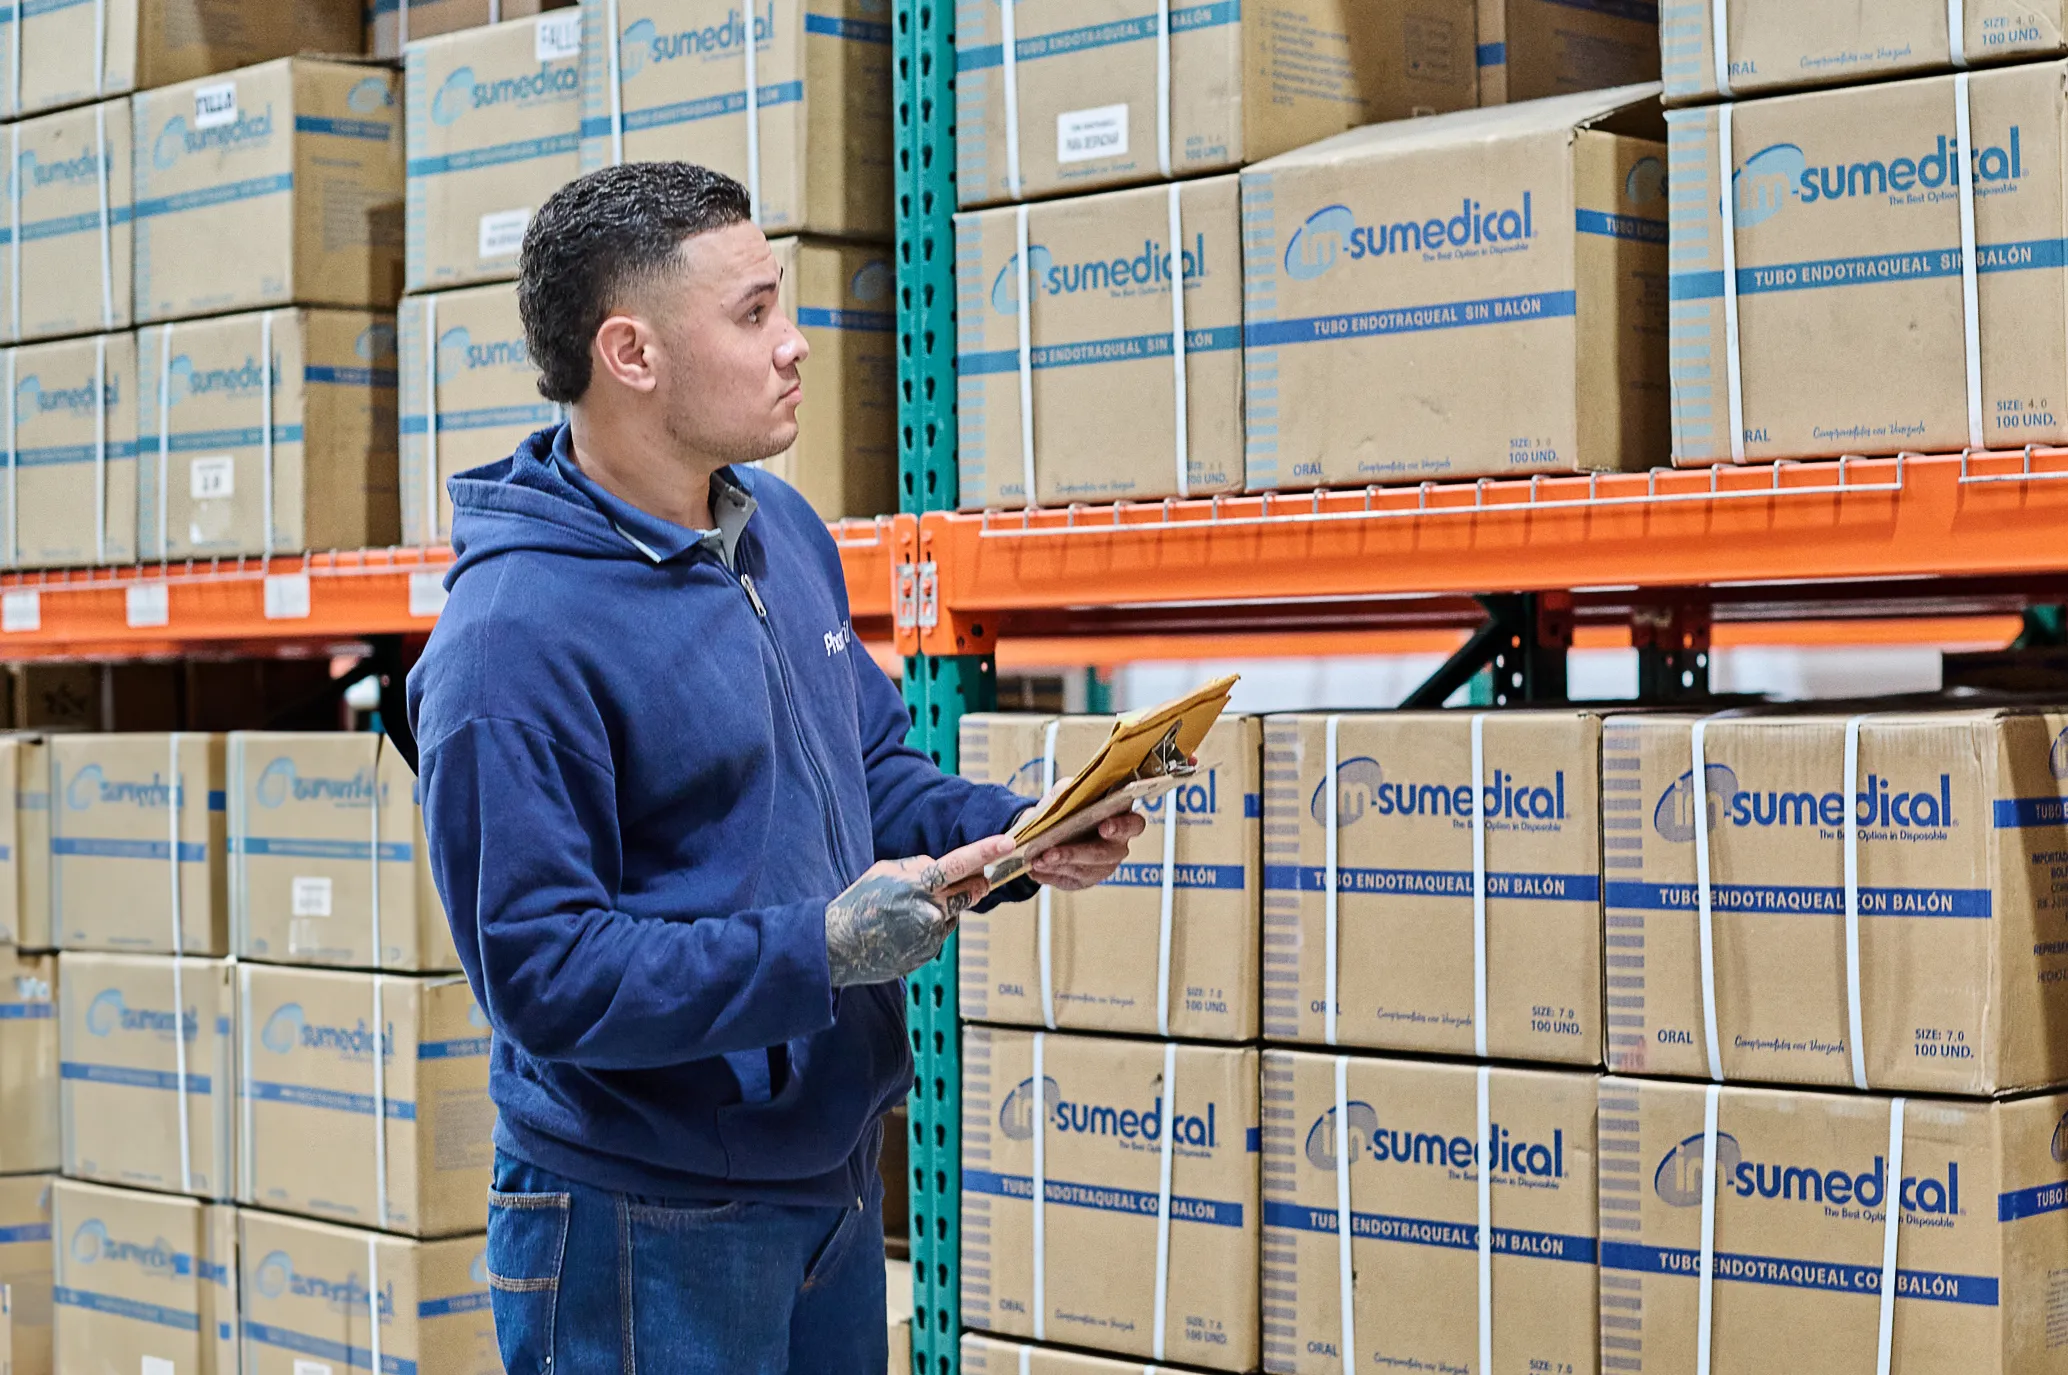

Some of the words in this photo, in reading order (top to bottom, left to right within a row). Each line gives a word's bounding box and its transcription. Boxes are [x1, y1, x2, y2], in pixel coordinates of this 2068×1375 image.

[1981, 33, 2005, 45] 100
[2008, 28, 2041, 43] UND.
[1728, 60, 1757, 76] RAL
[1889, 195, 1904, 205] The
[1927, 190, 1957, 203] Option
[1972, 184, 2018, 200] isposable
[1755, 269, 1797, 287] TUBO
[1802, 255, 1931, 282] ENDOTRAQUEAL
[1940, 251, 1964, 269] SIN
[1977, 246, 2032, 267] BALÓN
[1314, 318, 1348, 336] TUBO
[1352, 307, 1458, 332] ENDOTRAQUEAL
[1465, 303, 1489, 321] SIN
[1494, 298, 1541, 318] BALÓN
[1050, 342, 1141, 361] ENDOTRAQUEAL
[1147, 338, 1168, 353] SIN
[1996, 400, 2023, 412] SIZE:
[1995, 415, 2019, 429] 100
[2022, 413, 2056, 428] UND.
[1744, 428, 1770, 443] RAL
[1508, 451, 1529, 464] 100
[1531, 449, 1560, 463] UND.
[1293, 462, 1324, 476] ORAL
[1819, 830, 1834, 840] The
[1858, 830, 1887, 842] Option
[1890, 831, 1897, 840] in
[1900, 830, 1947, 843] Disposable
[1174, 867, 1216, 885] BALÓN
[1357, 874, 1473, 893] ENDOTRAQUEAL
[1487, 880, 1508, 894] ON
[1514, 878, 1564, 895] BALÓN
[1659, 888, 1699, 905] TUBO
[1710, 889, 1844, 910] ENDOTRAQUEAL
[1857, 893, 1887, 911] ON
[1893, 891, 1953, 912] BALÓN
[1532, 1006, 1554, 1017] SIZE:
[1531, 1019, 1551, 1032] 100
[1553, 1021, 1583, 1036] UND.
[1915, 1028, 1942, 1041] SIZE:
[1947, 1030, 1964, 1042] 7.0
[1658, 1029, 1693, 1045] ORAL
[1914, 1044, 1936, 1057] 100
[1940, 1044, 1975, 1059] UND.
[1050, 1097, 1215, 1148] -sumedcal
[1727, 1156, 1958, 1215] -sumedcal
[1044, 1183, 1136, 1210] NDOTRAQUEAL
[1140, 1197, 1159, 1213] CO
[1172, 1197, 1216, 1219] BALÓN
[2037, 1188, 2062, 1208] TUBO
[1824, 1207, 1839, 1217] The
[1842, 1208, 1861, 1220] Best
[1863, 1210, 1886, 1224] Opti
[1907, 1214, 1954, 1229] Disposable
[1309, 1212, 1340, 1229] TUB
[1352, 1219, 1470, 1245] ENDOTRAQUEAL
[1511, 1234, 1564, 1255] BALÓN
[1898, 1274, 1959, 1298] BALÓN
[1307, 1341, 1337, 1357] ORAL
